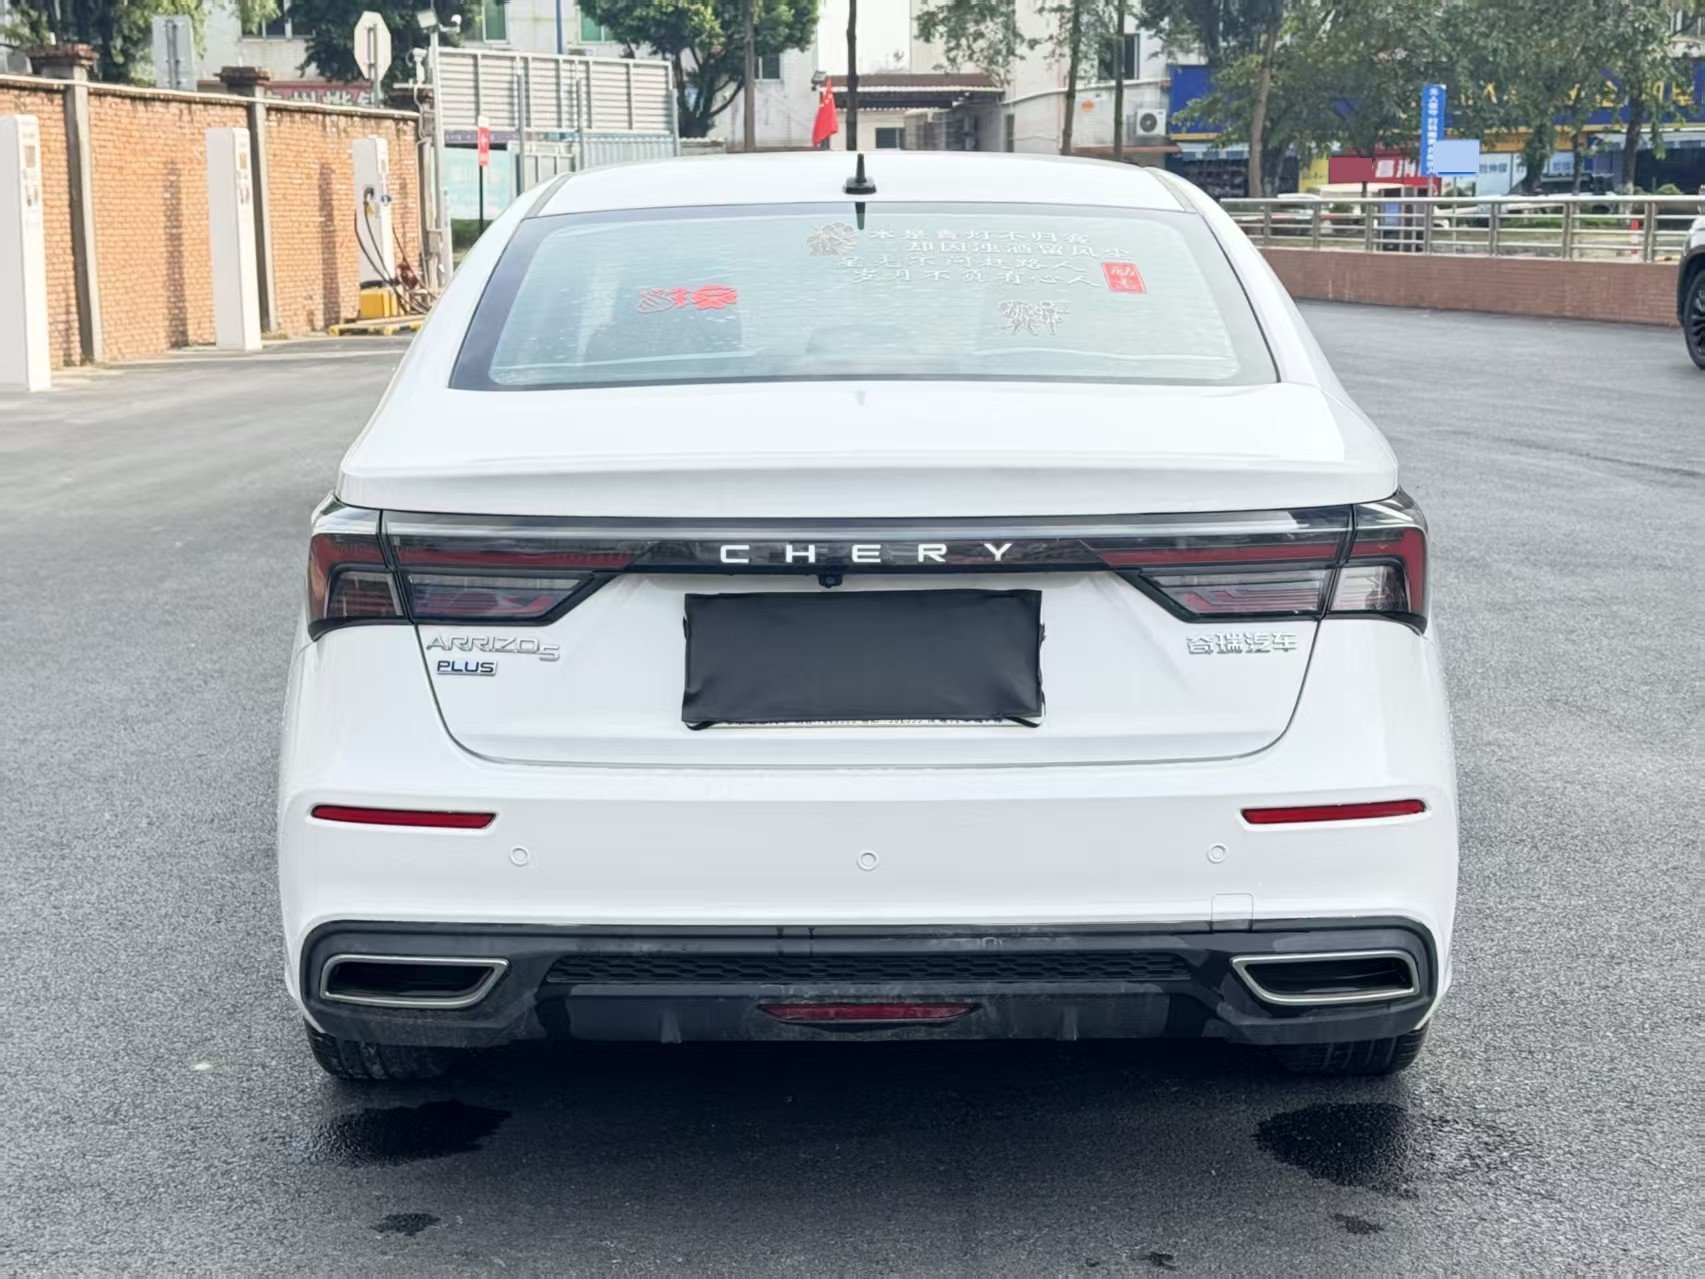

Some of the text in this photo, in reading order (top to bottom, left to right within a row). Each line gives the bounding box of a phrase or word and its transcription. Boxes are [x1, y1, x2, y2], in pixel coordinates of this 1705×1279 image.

[720, 542, 1013, 565] CHERY
[1186, 632, 1297, 655] 奇瑞汽车
[437, 660, 495, 674] PLUS
